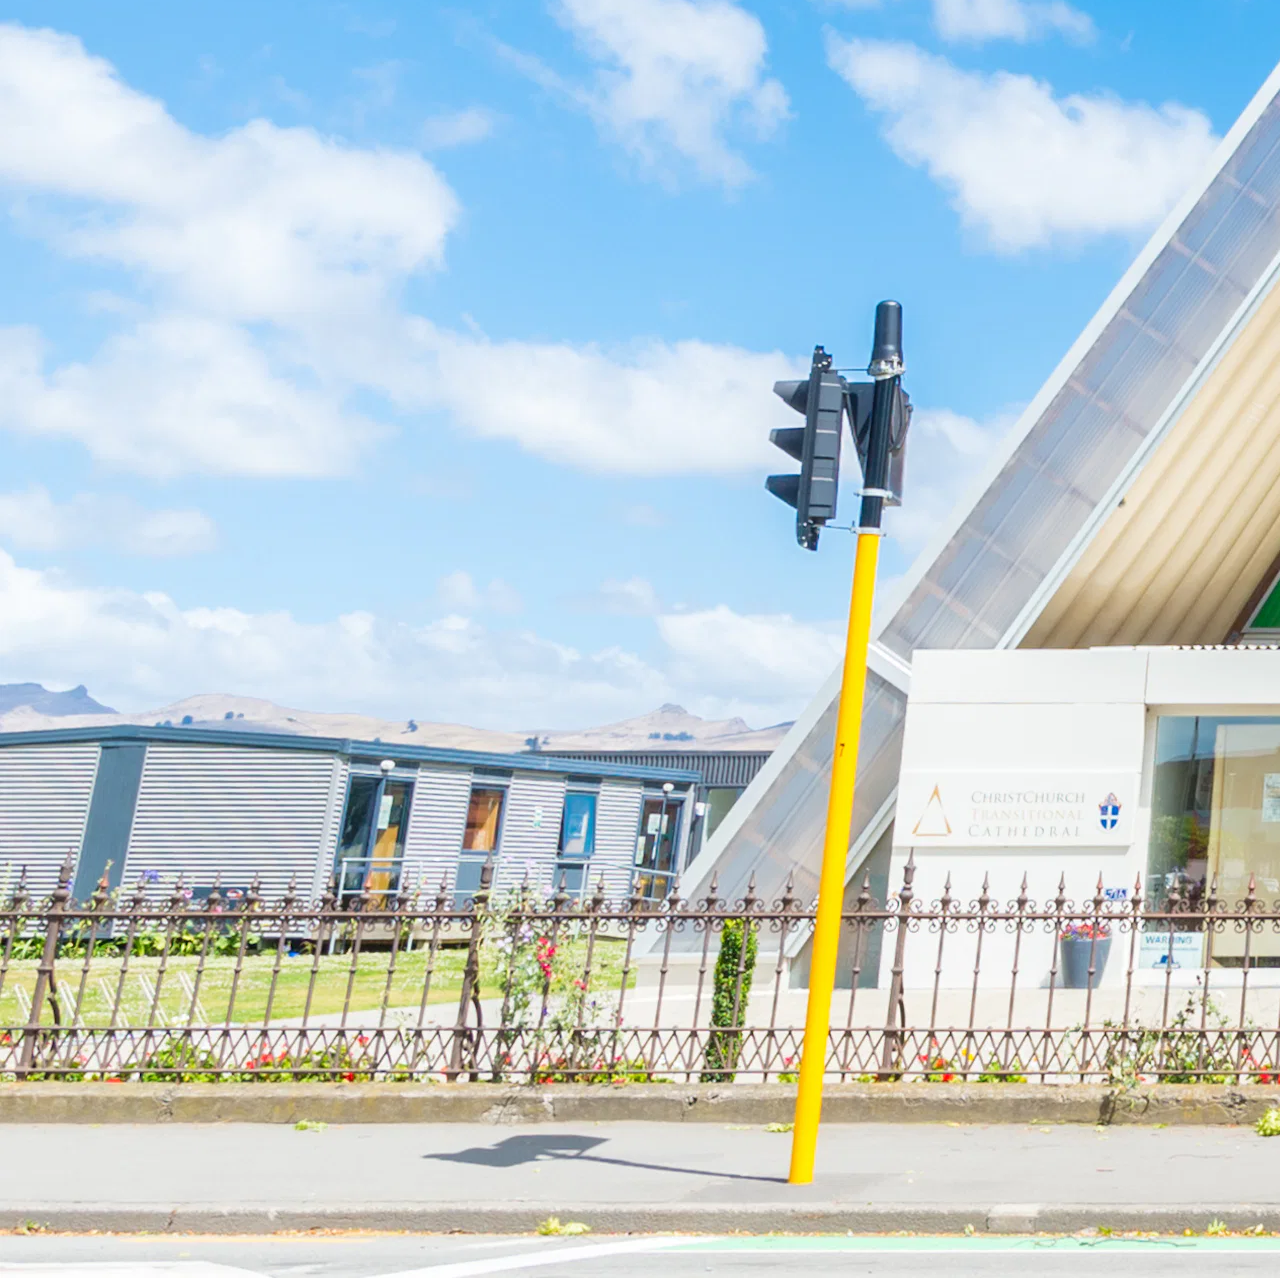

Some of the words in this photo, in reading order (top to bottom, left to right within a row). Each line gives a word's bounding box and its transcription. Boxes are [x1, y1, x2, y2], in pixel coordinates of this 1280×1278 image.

[971, 790, 1085, 804] CHRISTCHURCH
[972, 808, 1085, 821] TRANSITIONAL
[968, 824, 1081, 837] CATHEDRAL
[1145, 935, 1193, 944] WARING
